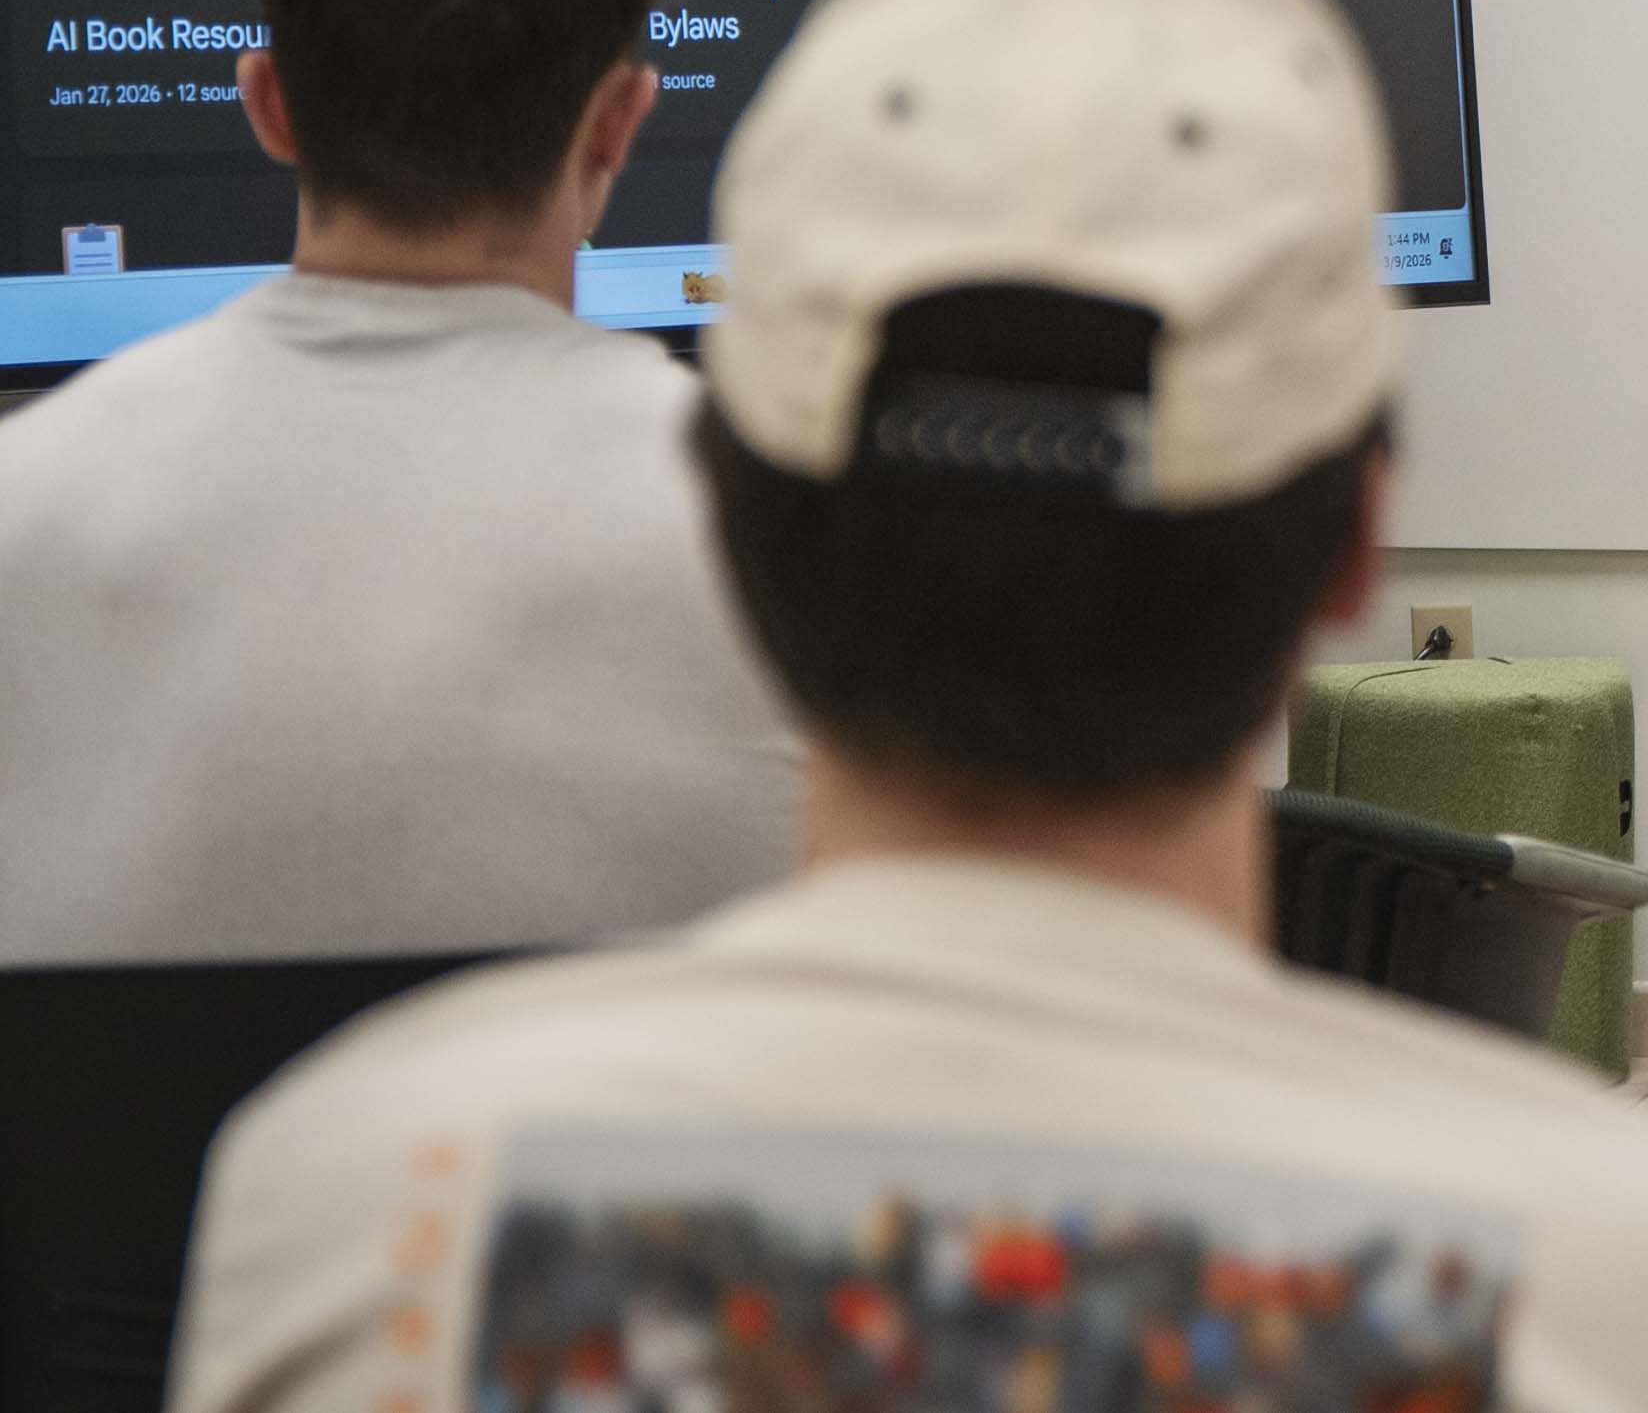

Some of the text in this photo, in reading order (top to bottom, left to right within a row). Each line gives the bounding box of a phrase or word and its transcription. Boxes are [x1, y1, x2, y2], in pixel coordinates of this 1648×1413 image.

[47, 20, 76, 52] AI
[87, 18, 162, 51] Book
[650, 9, 739, 47] Bylaws
[662, 74, 715, 89] source
[50, 86, 82, 106] Jan
[88, 87, 112, 107] 27,
[116, 85, 160, 104] 2026
[178, 84, 196, 102] 12
[1413, 232, 1430, 244] PM
